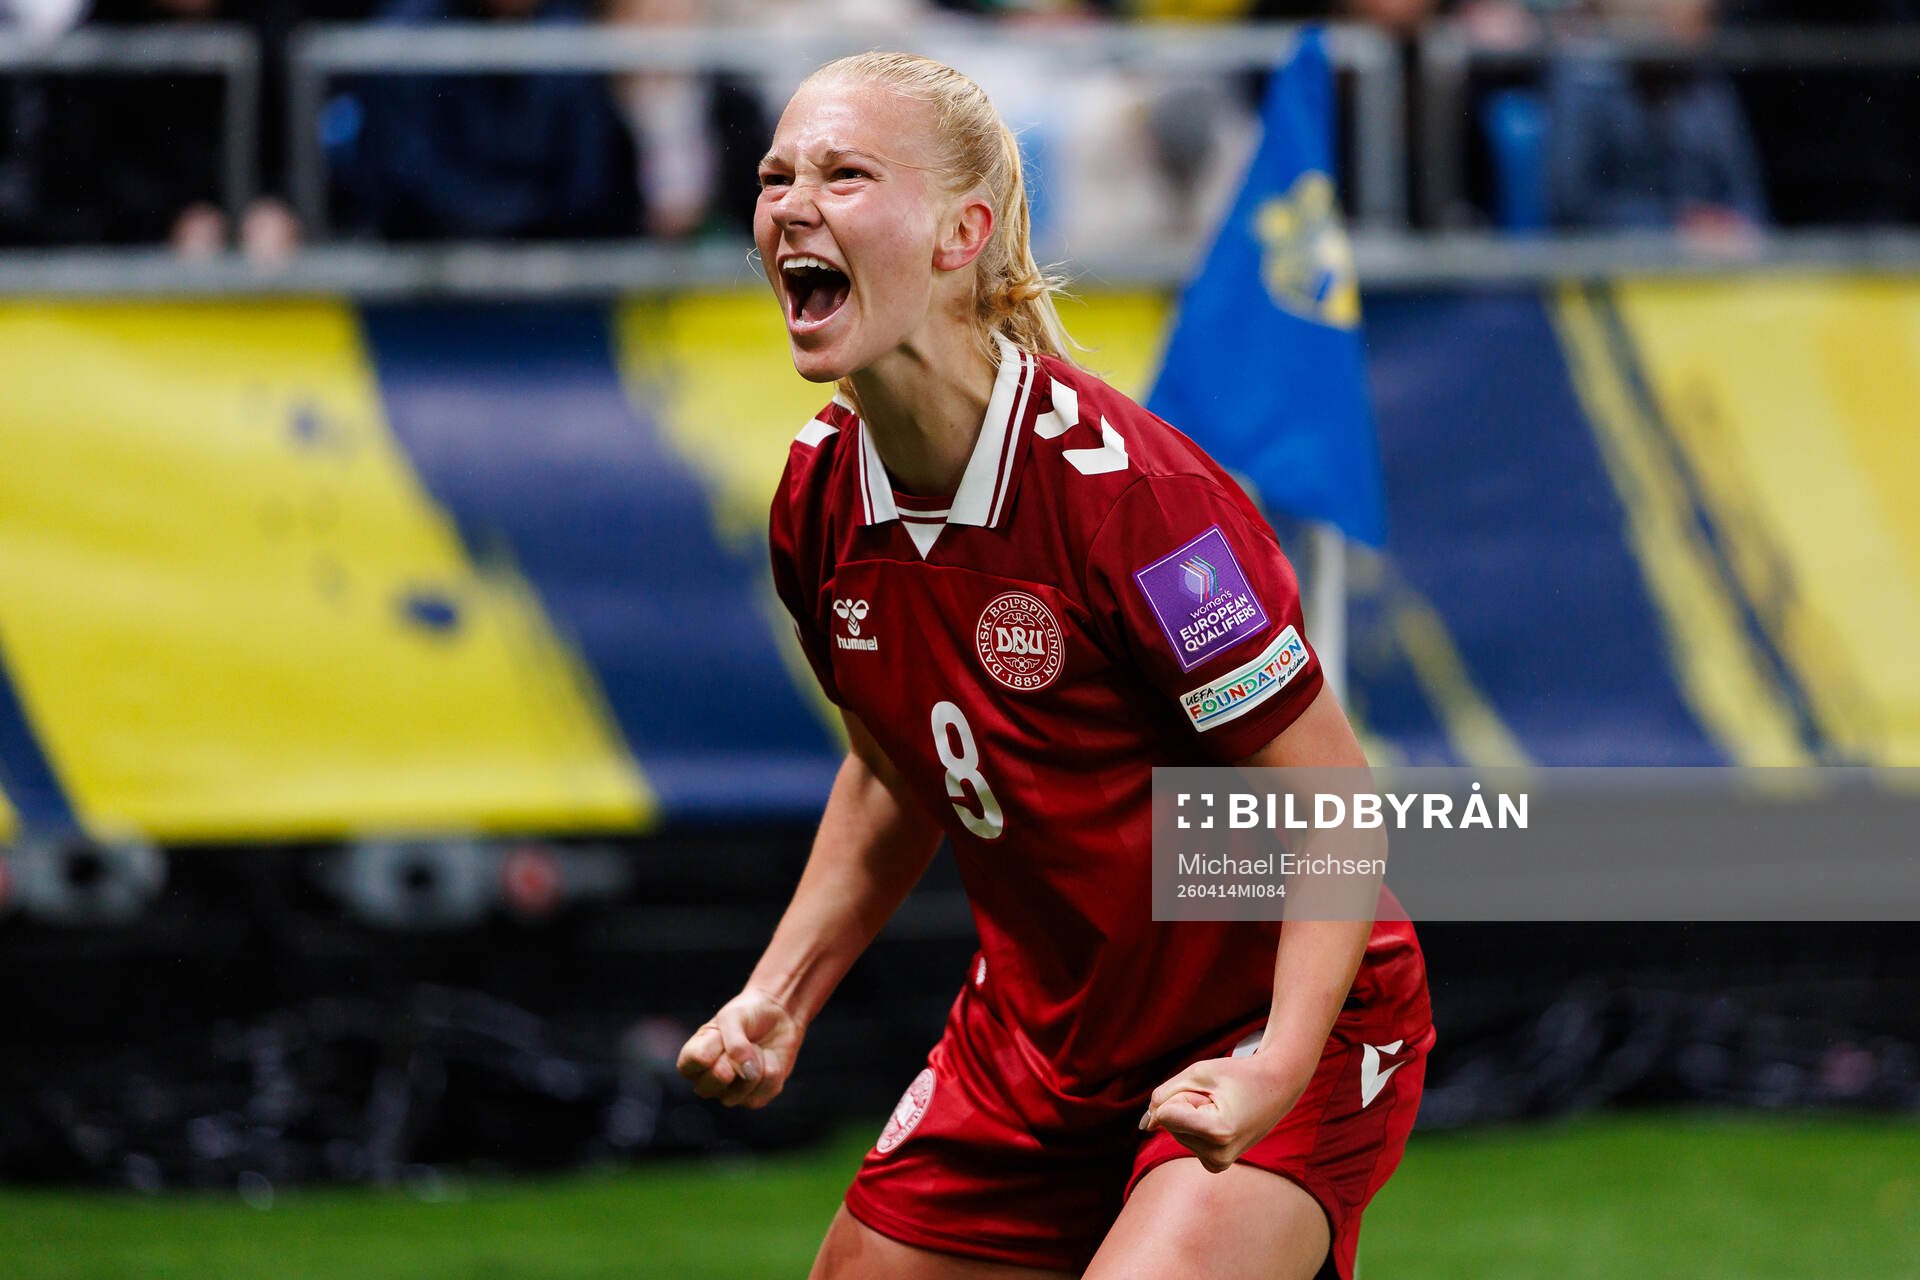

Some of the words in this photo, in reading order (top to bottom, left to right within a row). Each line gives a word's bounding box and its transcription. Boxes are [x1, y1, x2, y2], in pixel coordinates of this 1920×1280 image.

[1179, 593, 1249, 641] EUROPEAN
[1190, 590, 1232, 619] women's
[836, 634, 878, 651] hummel
[995, 626, 1046, 655] DBU
[1185, 604, 1256, 652] QUALIFIERS
[980, 619, 1003, 675] DANSK
[1006, 673, 1041, 687] 1889
[1185, 688, 1214, 706] UEFA
